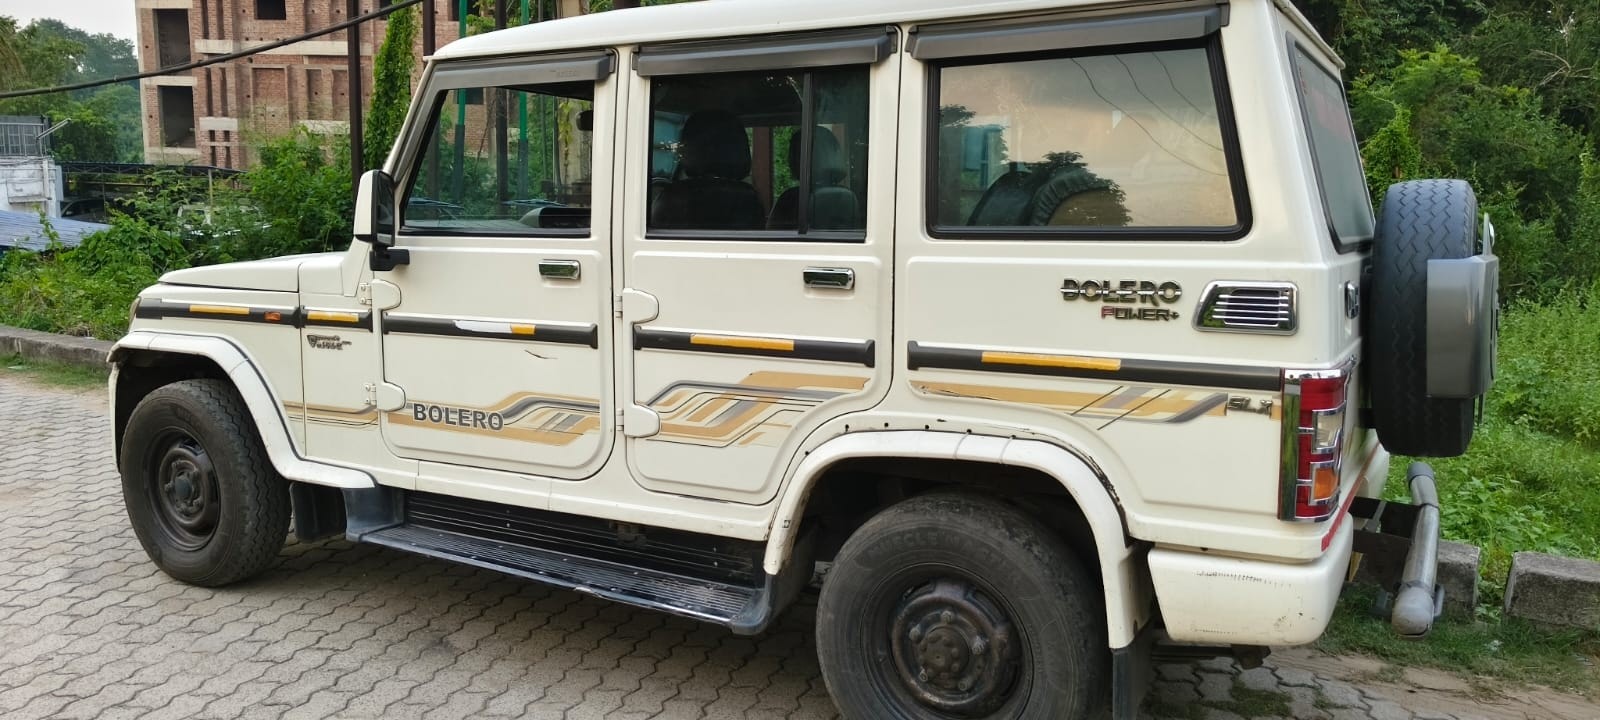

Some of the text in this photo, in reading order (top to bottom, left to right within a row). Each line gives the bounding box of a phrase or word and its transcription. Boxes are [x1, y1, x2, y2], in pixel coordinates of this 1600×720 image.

[1060, 278, 1183, 307] BOLERO
[1101, 306, 1180, 322] POWER+
[413, 402, 504, 431] BOLERO
